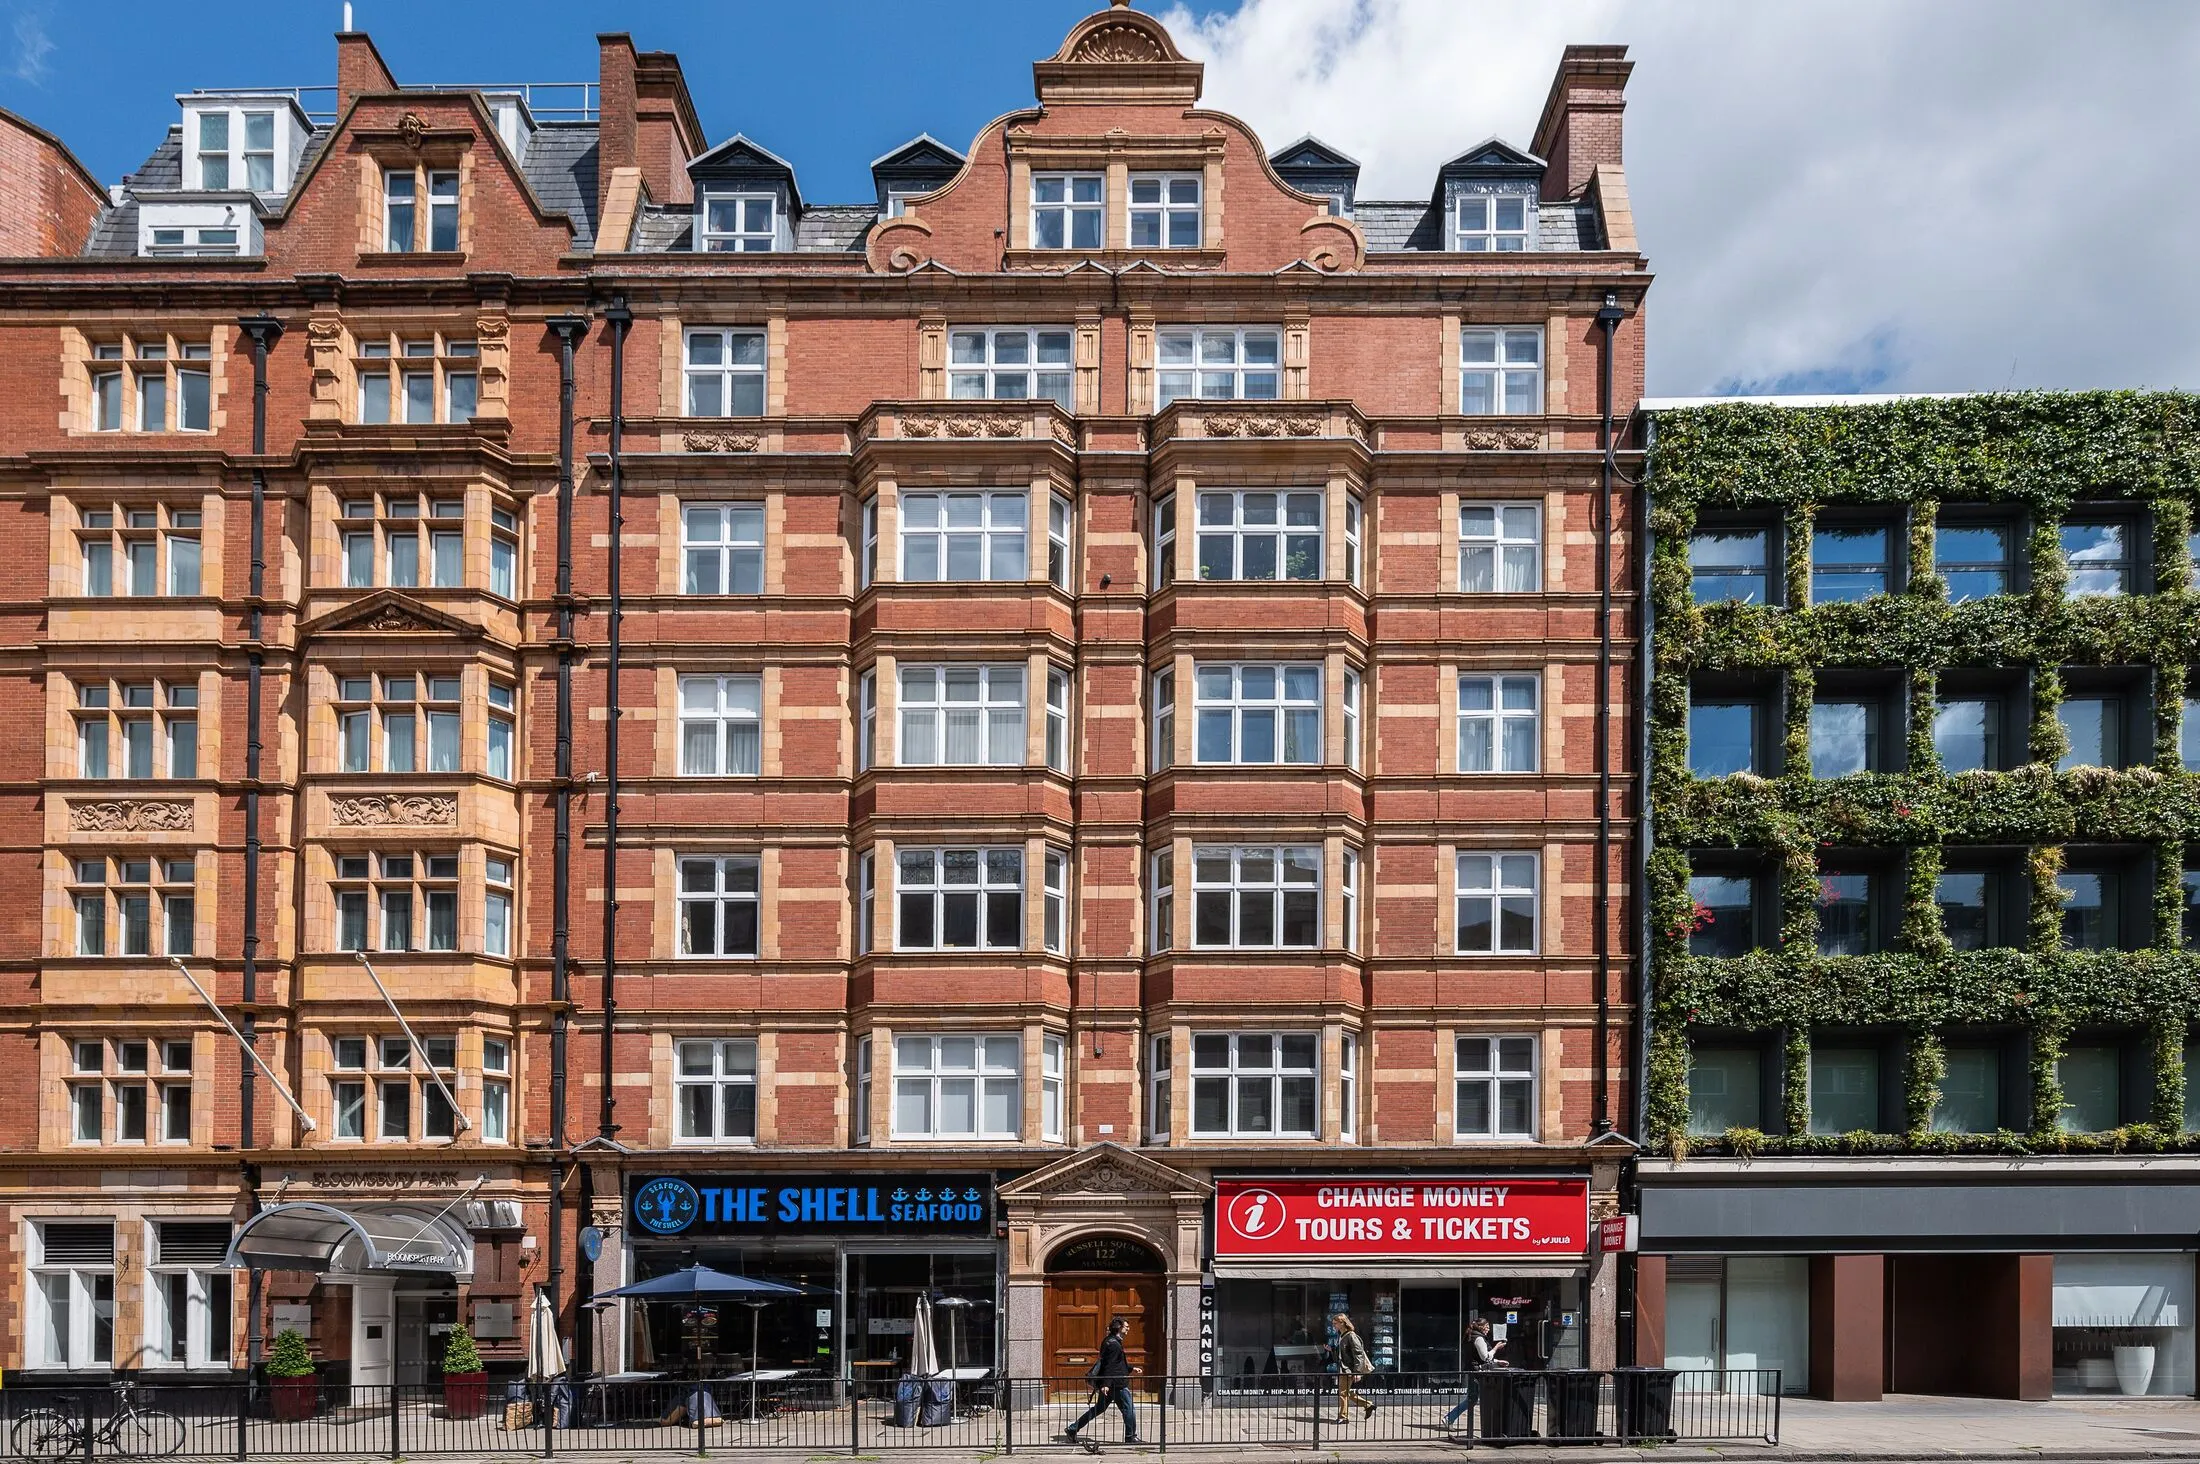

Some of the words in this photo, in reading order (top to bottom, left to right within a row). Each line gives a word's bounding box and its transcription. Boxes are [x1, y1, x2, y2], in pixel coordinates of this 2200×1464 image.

[312, 1171, 416, 1188] BLOOMSBURY
[421, 1171, 460, 1188] PARK
[648, 1182, 685, 1195] SEAFOOD
[700, 1188, 769, 1222] THE
[778, 1187, 885, 1223] SHELL
[1317, 1187, 1415, 1208] CHANGE
[1422, 1187, 1509, 1208] MONEY
[890, 1203, 982, 1222] SEAFOOD
[1294, 1217, 1383, 1241] TOURS
[1391, 1217, 1413, 1241] &
[1420, 1217, 1531, 1241] TICKETS
[1603, 1222, 1624, 1234] CHANGE
[1532, 1238, 1541, 1246] by
[1604, 1235, 1622, 1246] MONEY
[1065, 1240, 1106, 1257] RUSSELL
[1110, 1240, 1145, 1257] SQUARE
[1095, 1249, 1116, 1259] 122
[430, 1255, 446, 1264] PARK
[1490, 1297, 1510, 1305] City
[1511, 1296, 1532, 1305] Tour
[1201, 1296, 1213, 1376] CHANGE
